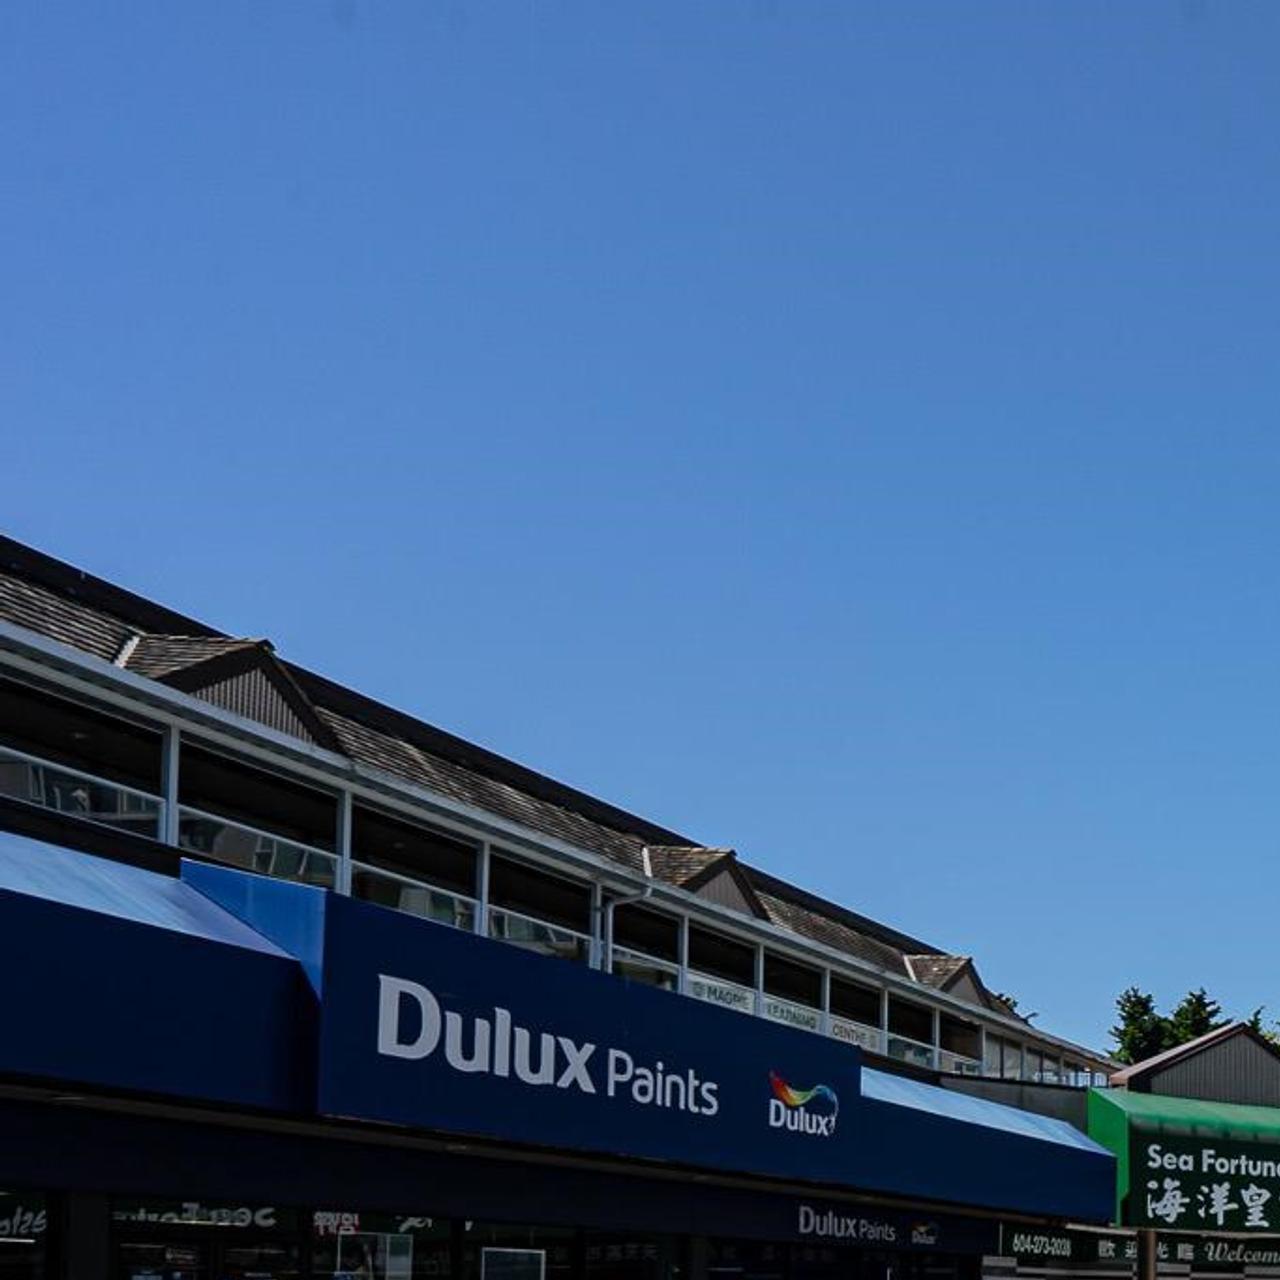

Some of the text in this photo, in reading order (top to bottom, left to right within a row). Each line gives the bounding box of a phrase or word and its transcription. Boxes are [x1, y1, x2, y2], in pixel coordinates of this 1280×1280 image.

[378, 973, 719, 1115] Dulux Paints
[769, 1100, 831, 1136] Dulux
[1147, 1144, 1194, 1171] Sea
[799, 1205, 897, 1242] Dulux Paints
